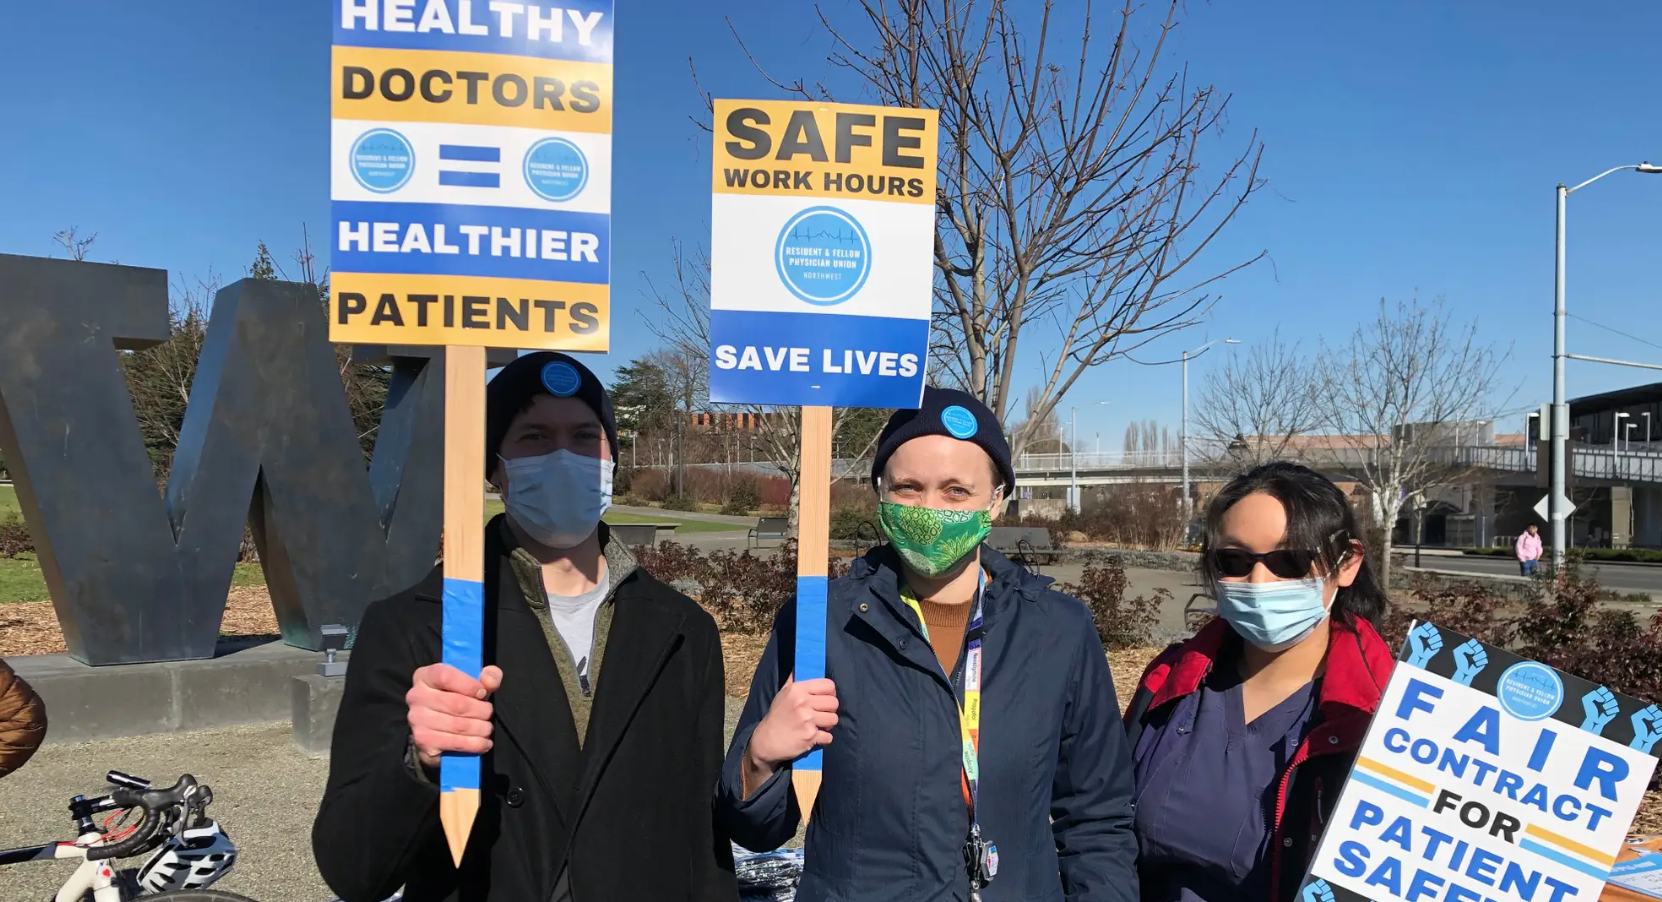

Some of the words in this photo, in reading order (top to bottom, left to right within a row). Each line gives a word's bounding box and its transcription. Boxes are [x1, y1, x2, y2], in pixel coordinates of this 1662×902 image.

[341, 0, 604, 47] HEALTHY
[342, 66, 601, 114] DOCTORS
[725, 107, 926, 169] SAFE
[724, 168, 813, 190] WORK
[824, 172, 924, 198] HOURS
[338, 221, 600, 264] HEALTHIER
[786, 246, 822, 256] RESIDENT
[824, 248, 830, 257] &
[832, 249, 860, 258] FELLOW
[789, 258, 830, 268] PHYSICIAN
[833, 260, 856, 268] UNION
[804, 272, 842, 280] NORTHWEST
[337, 292, 600, 335] PATIENTS
[715, 345, 811, 372] SAVE
[822, 349, 919, 378] LIVES
[1395, 678, 1630, 802] FAIR
[1382, 727, 1613, 832] CONTRACT
[1432, 789, 1522, 844] FOR
[1348, 800, 1579, 902] PATIENT
